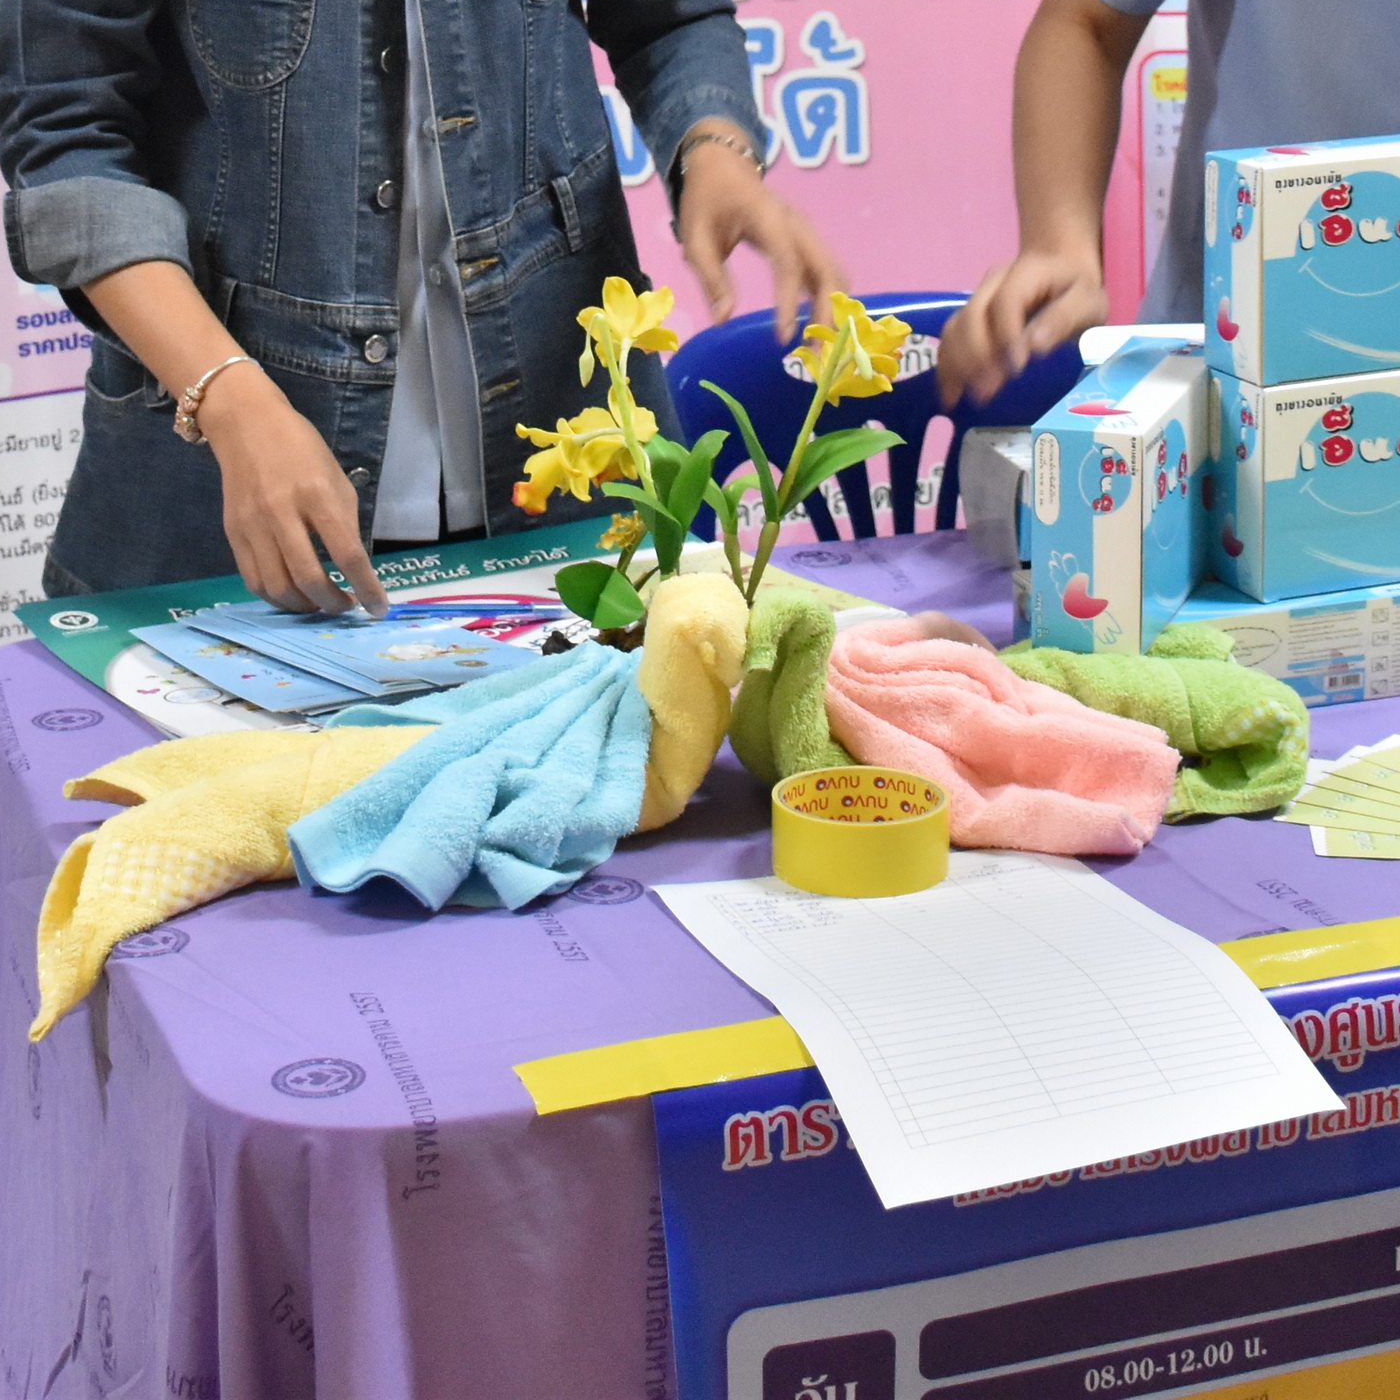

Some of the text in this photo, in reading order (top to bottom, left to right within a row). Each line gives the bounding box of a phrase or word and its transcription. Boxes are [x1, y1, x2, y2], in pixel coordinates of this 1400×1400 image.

[1274, 171, 1343, 194] ถุงยางอนามัย
[1275, 393, 1343, 416] ถุงยางอนามัย
[69, 429, 80, 443] 2
[1084, 1335, 1268, 1393] 08.00-12.00 น.
